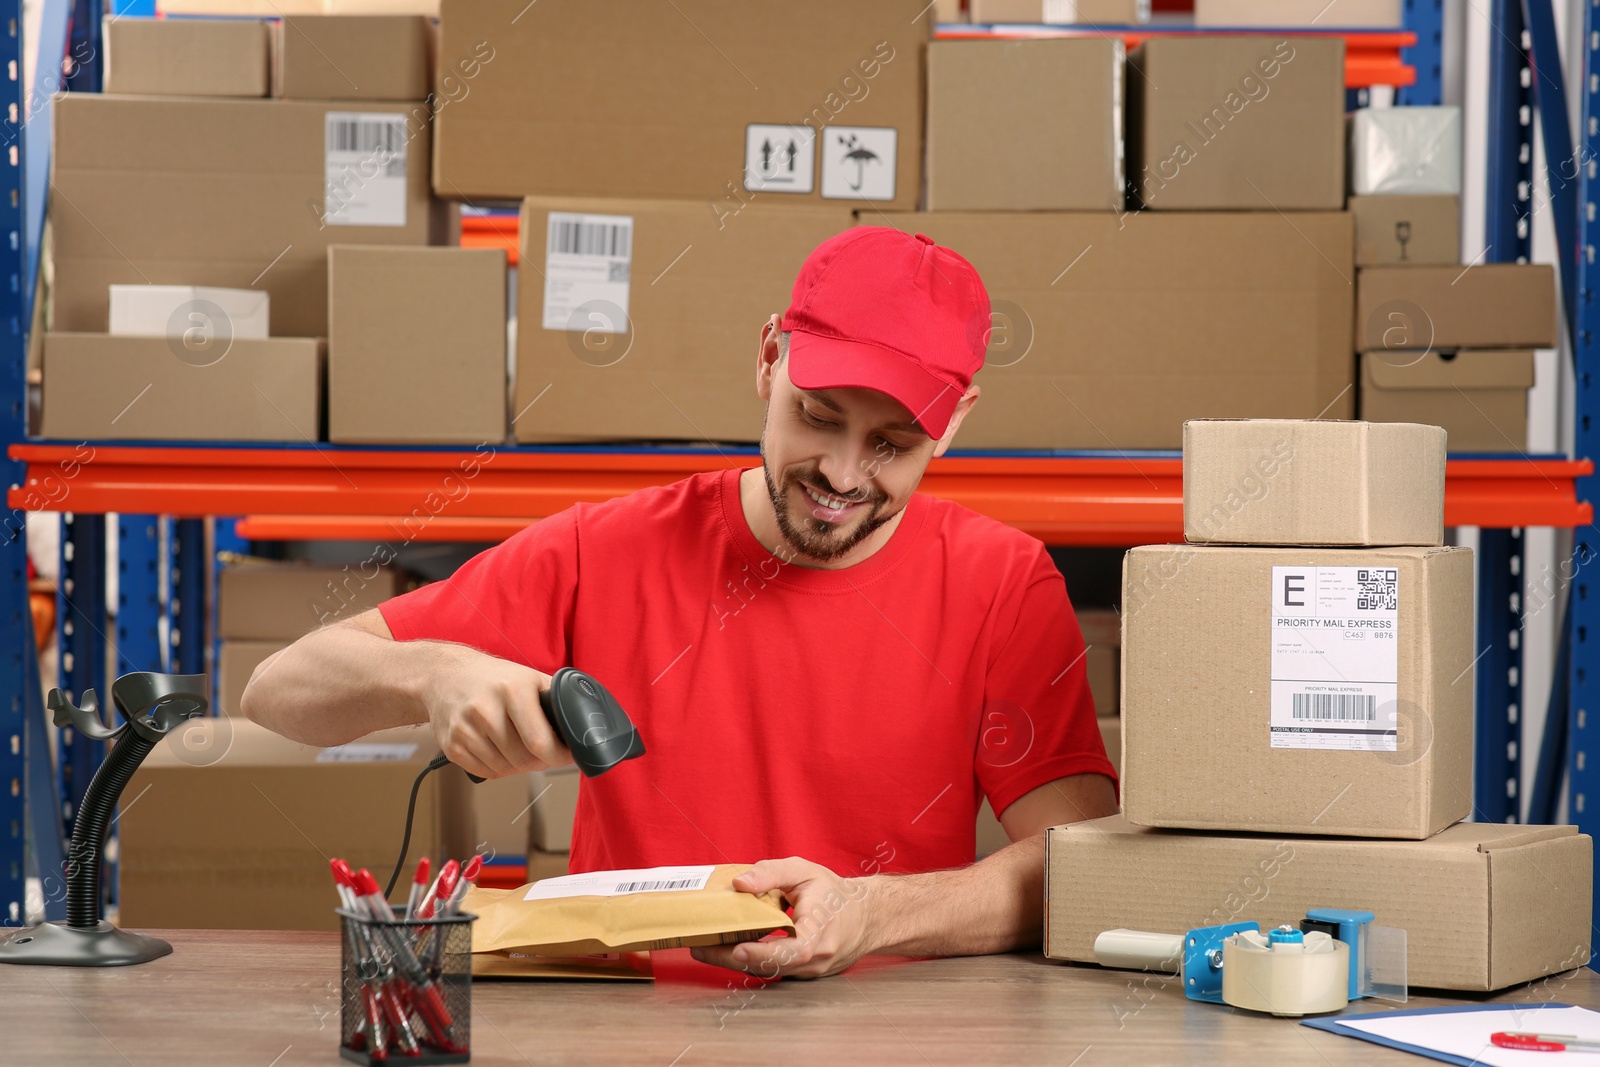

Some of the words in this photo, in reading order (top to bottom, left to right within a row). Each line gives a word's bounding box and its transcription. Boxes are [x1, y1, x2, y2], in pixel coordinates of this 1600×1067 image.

[1284, 575, 1305, 606] E
[1277, 618, 1321, 627] PRIORITY
[1323, 619, 1345, 627] MAIL
[1347, 619, 1392, 628] EXPRESS
[1344, 631, 1364, 639] C463
